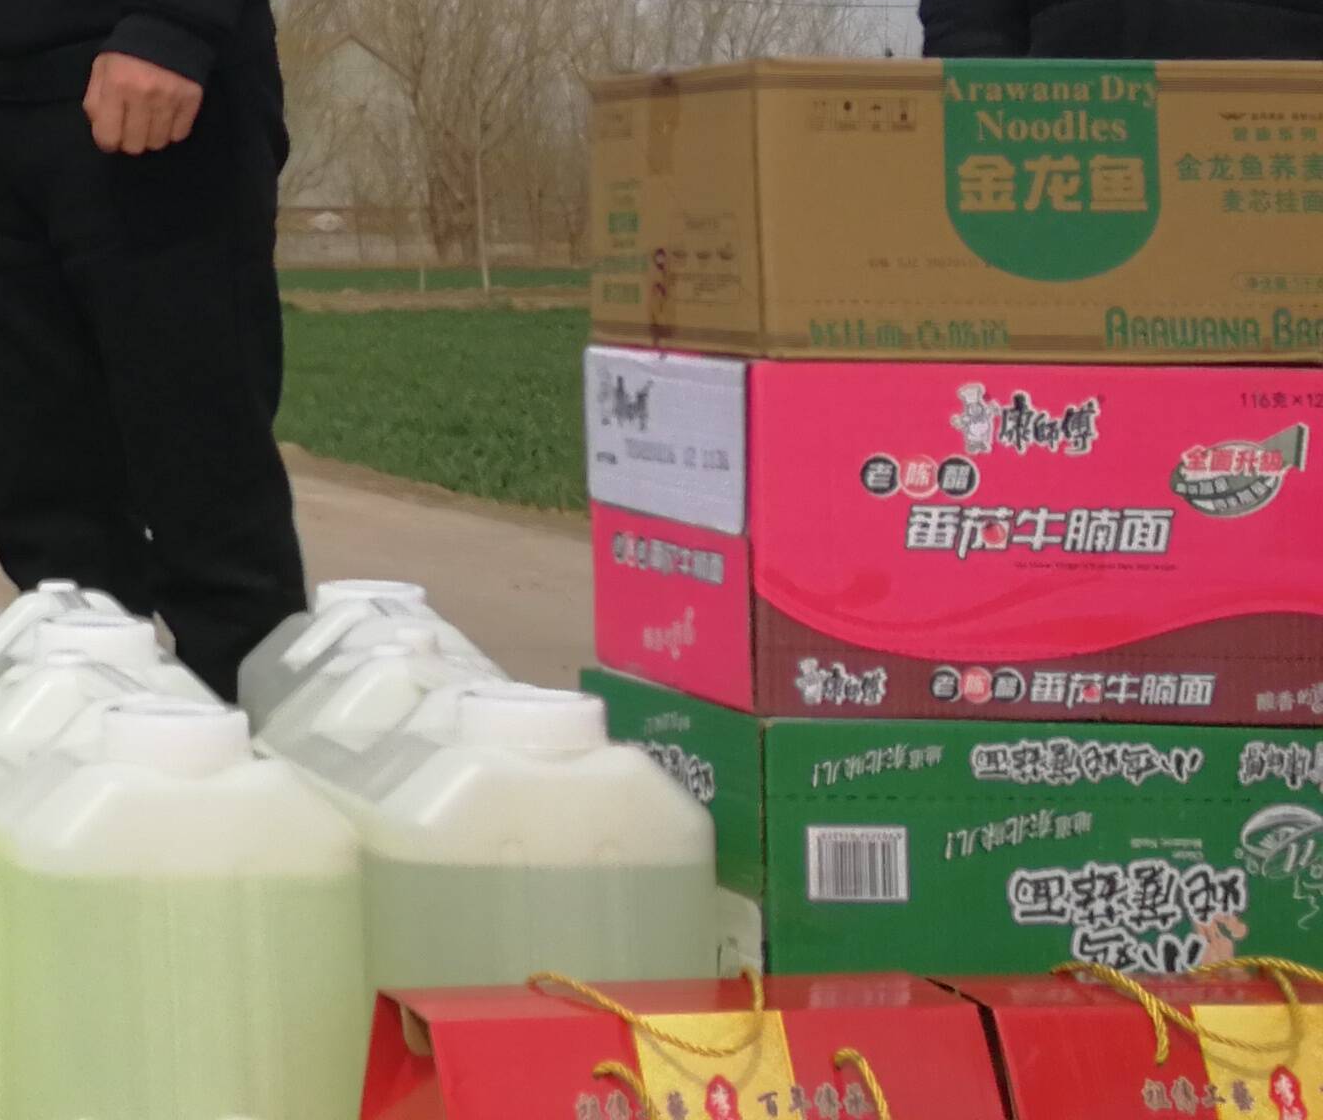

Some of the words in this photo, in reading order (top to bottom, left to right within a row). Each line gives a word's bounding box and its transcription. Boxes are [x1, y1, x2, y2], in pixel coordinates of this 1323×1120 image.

[945, 76, 1091, 103] Arawana
[1100, 75, 1158, 109] Dry
[976, 109, 1129, 144] Noodles
[957, 154, 1149, 213] 金龙鱼
[904, 505, 1175, 560] 番茄牛腩面
[1030, 671, 1216, 709] 番茄牛腩面
[970, 737, 1204, 786] 小鸡炖蘑菇面
[1008, 859, 1249, 930] 炖蘑菇面
